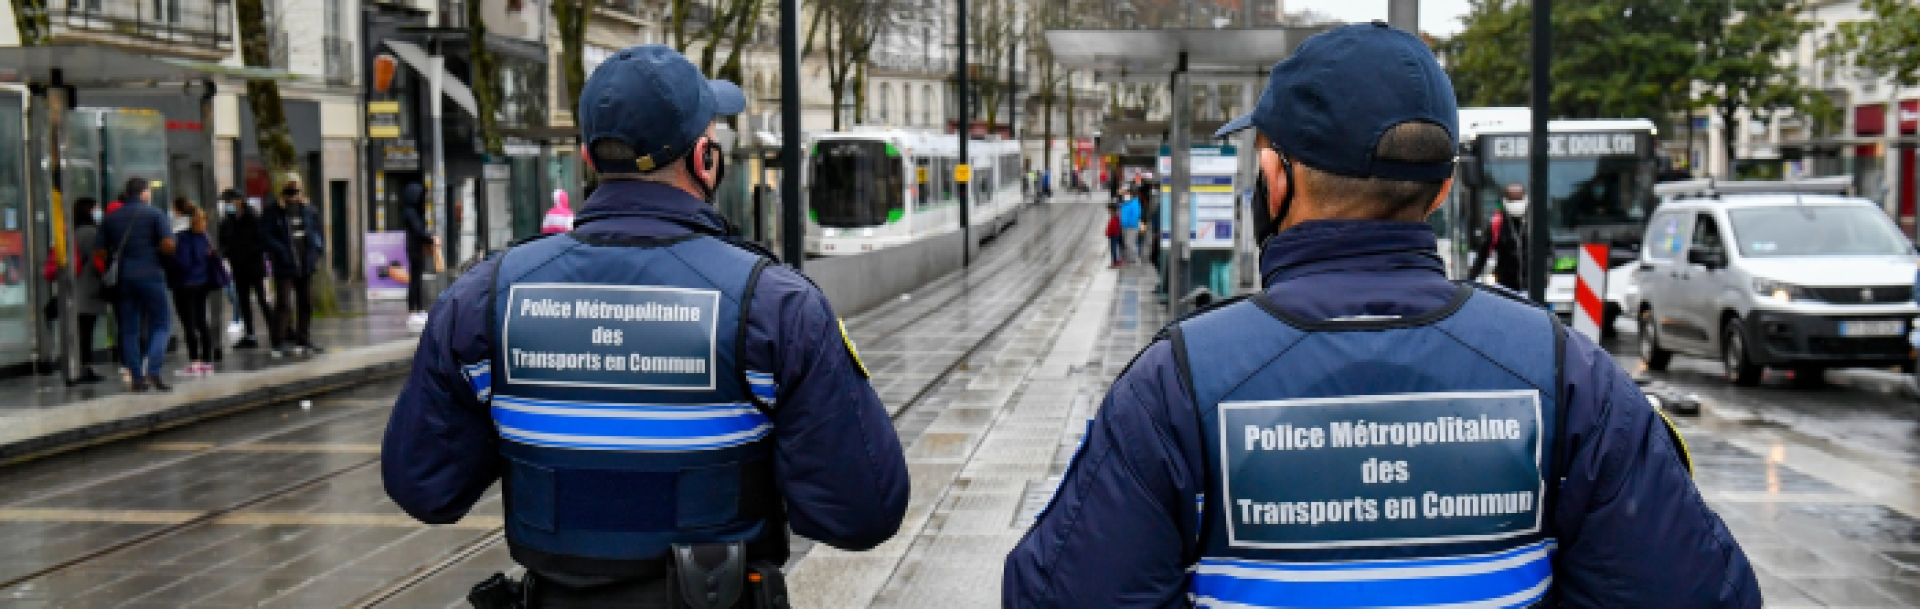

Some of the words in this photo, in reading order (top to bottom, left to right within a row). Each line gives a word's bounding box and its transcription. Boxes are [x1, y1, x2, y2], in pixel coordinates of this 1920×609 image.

[520, 298, 571, 318] Police
[575, 299, 701, 322] Métropolitaine
[592, 326, 624, 346] des
[512, 348, 601, 371] Transports
[605, 354, 626, 371] en
[630, 353, 706, 374] Commun
[1244, 424, 1325, 450] Police
[1330, 414, 1521, 447] Métropolitaine
[1361, 457, 1410, 484] des
[1237, 496, 1380, 526] Transports
[1384, 497, 1417, 519] en
[1422, 490, 1534, 519] Commun
